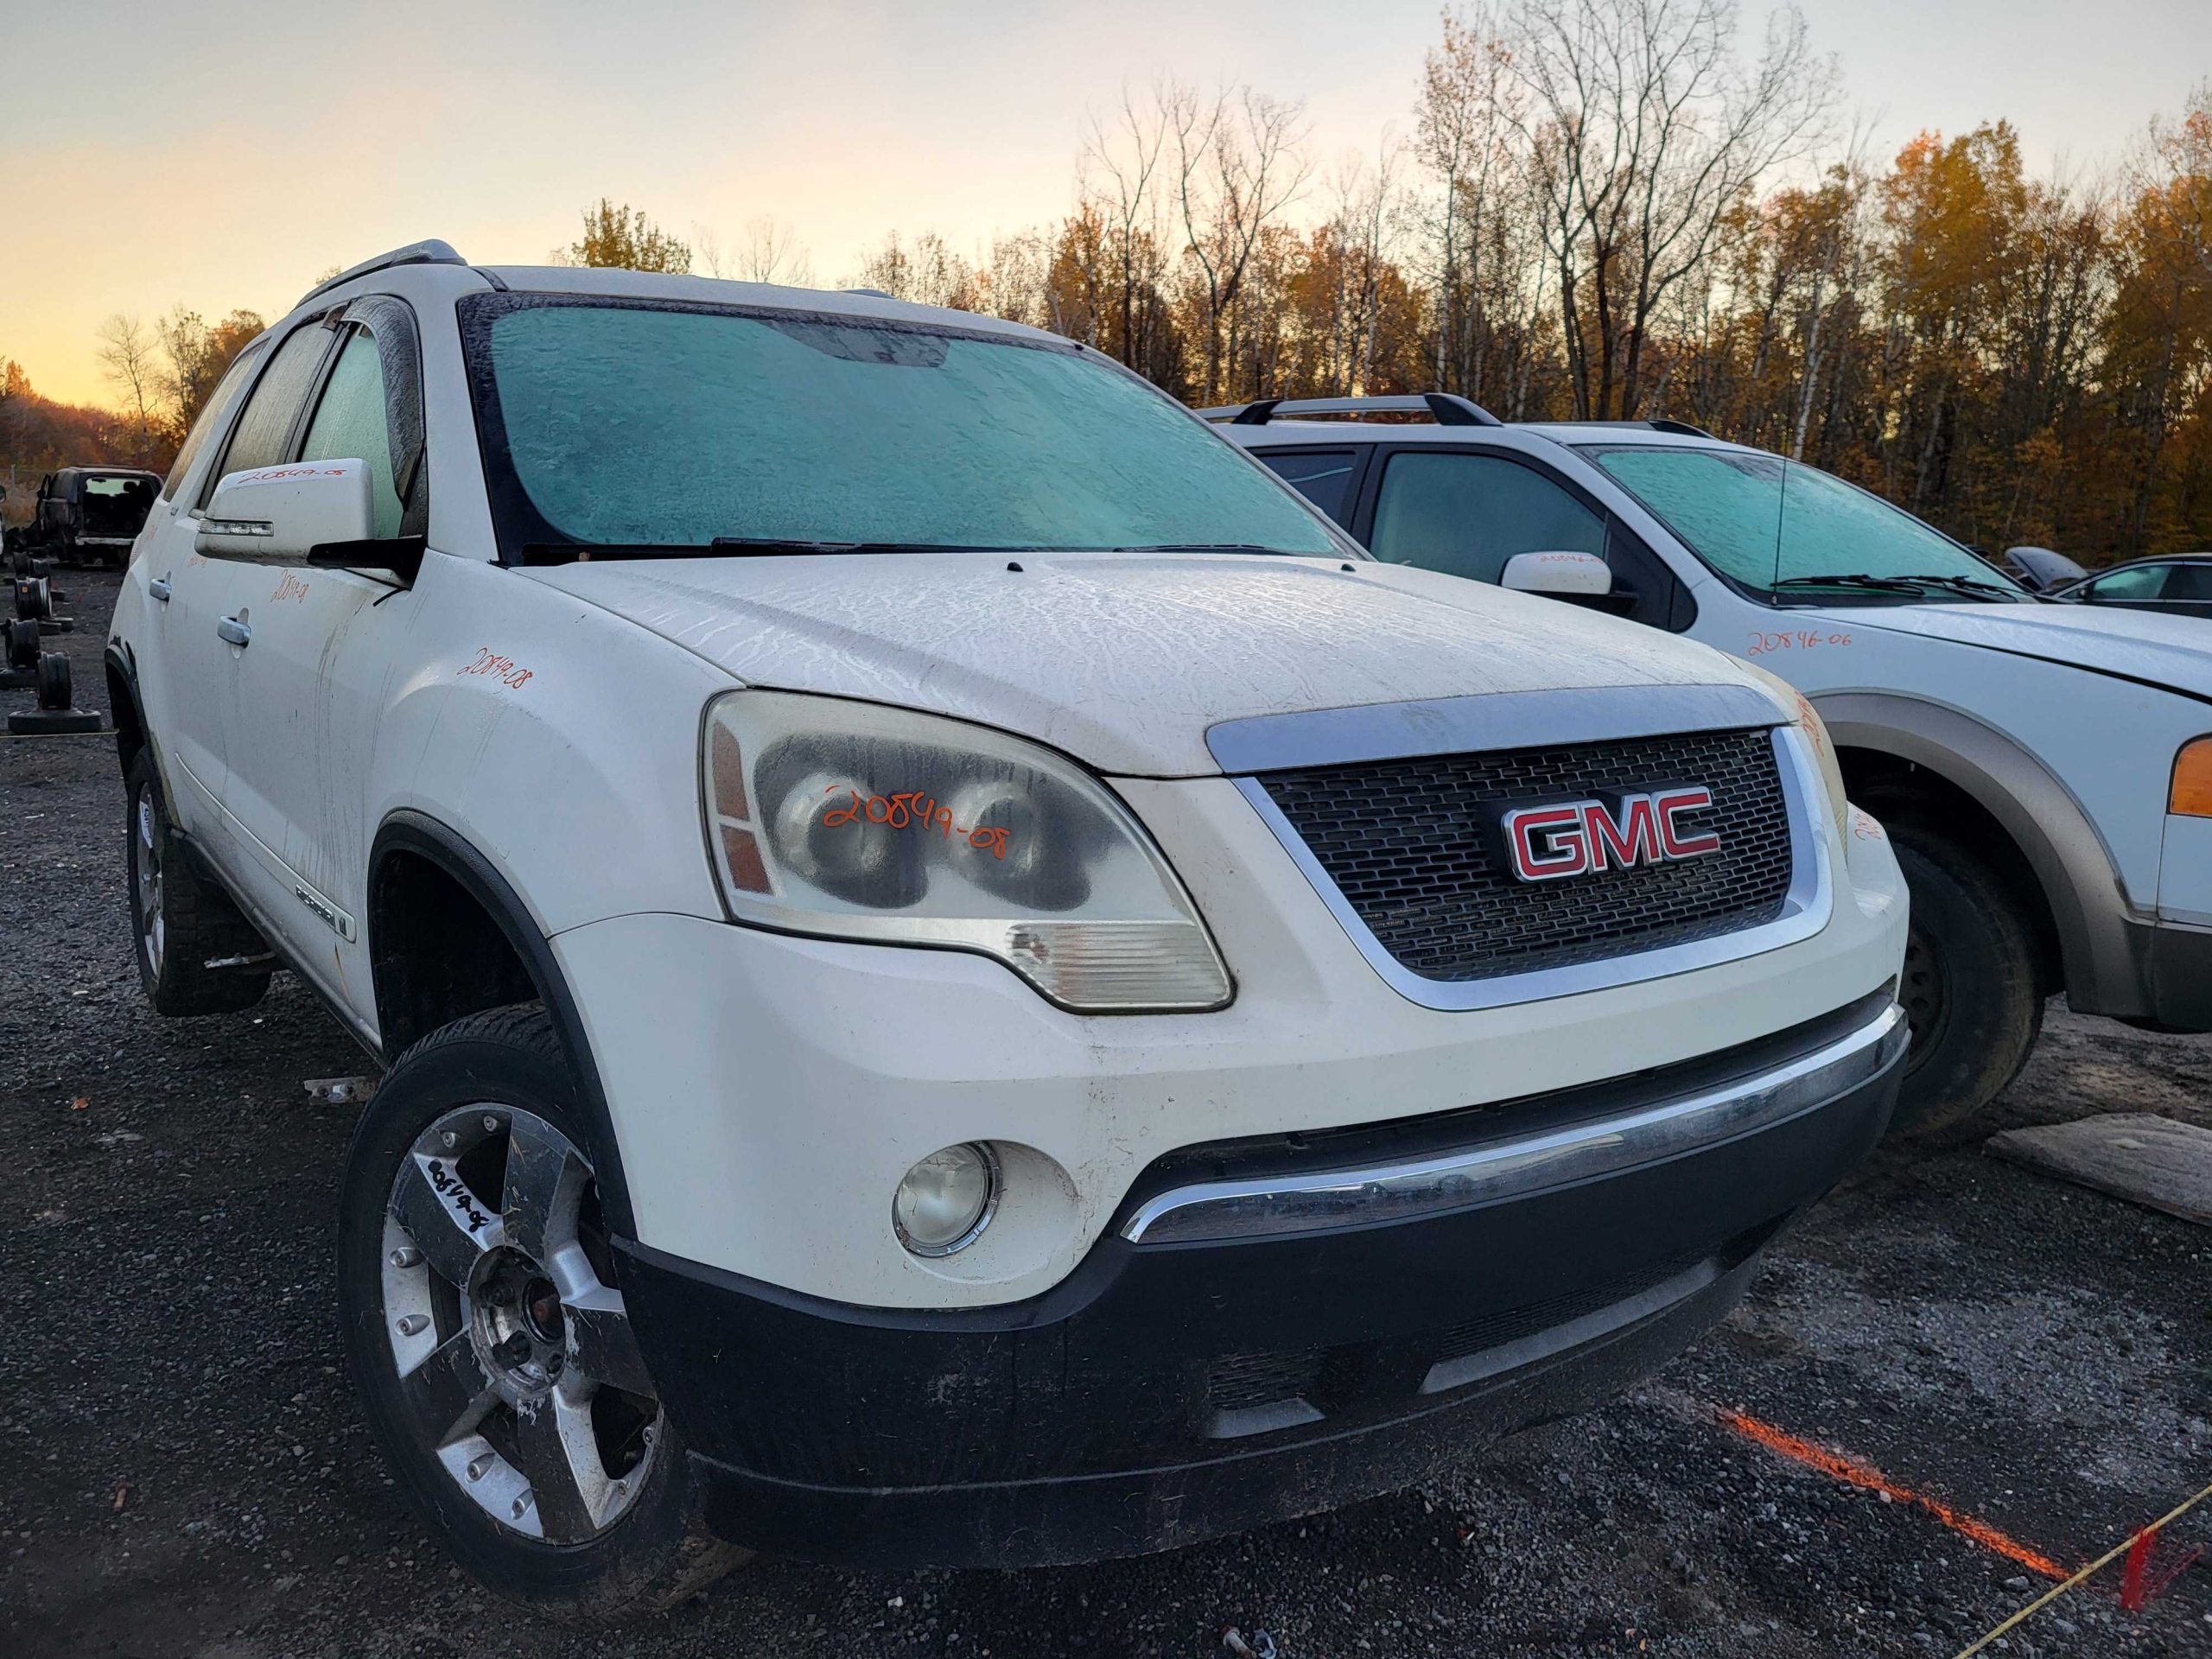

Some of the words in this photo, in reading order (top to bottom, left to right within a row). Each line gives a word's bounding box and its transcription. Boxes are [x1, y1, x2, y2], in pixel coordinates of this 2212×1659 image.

[237, 469, 347, 485] 20849-08
[1747, 630, 1852, 656] 20846-06
[456, 647, 533, 690] 20849-08
[823, 785, 1010, 861] 20849-08
[1502, 785, 1721, 884] GMC
